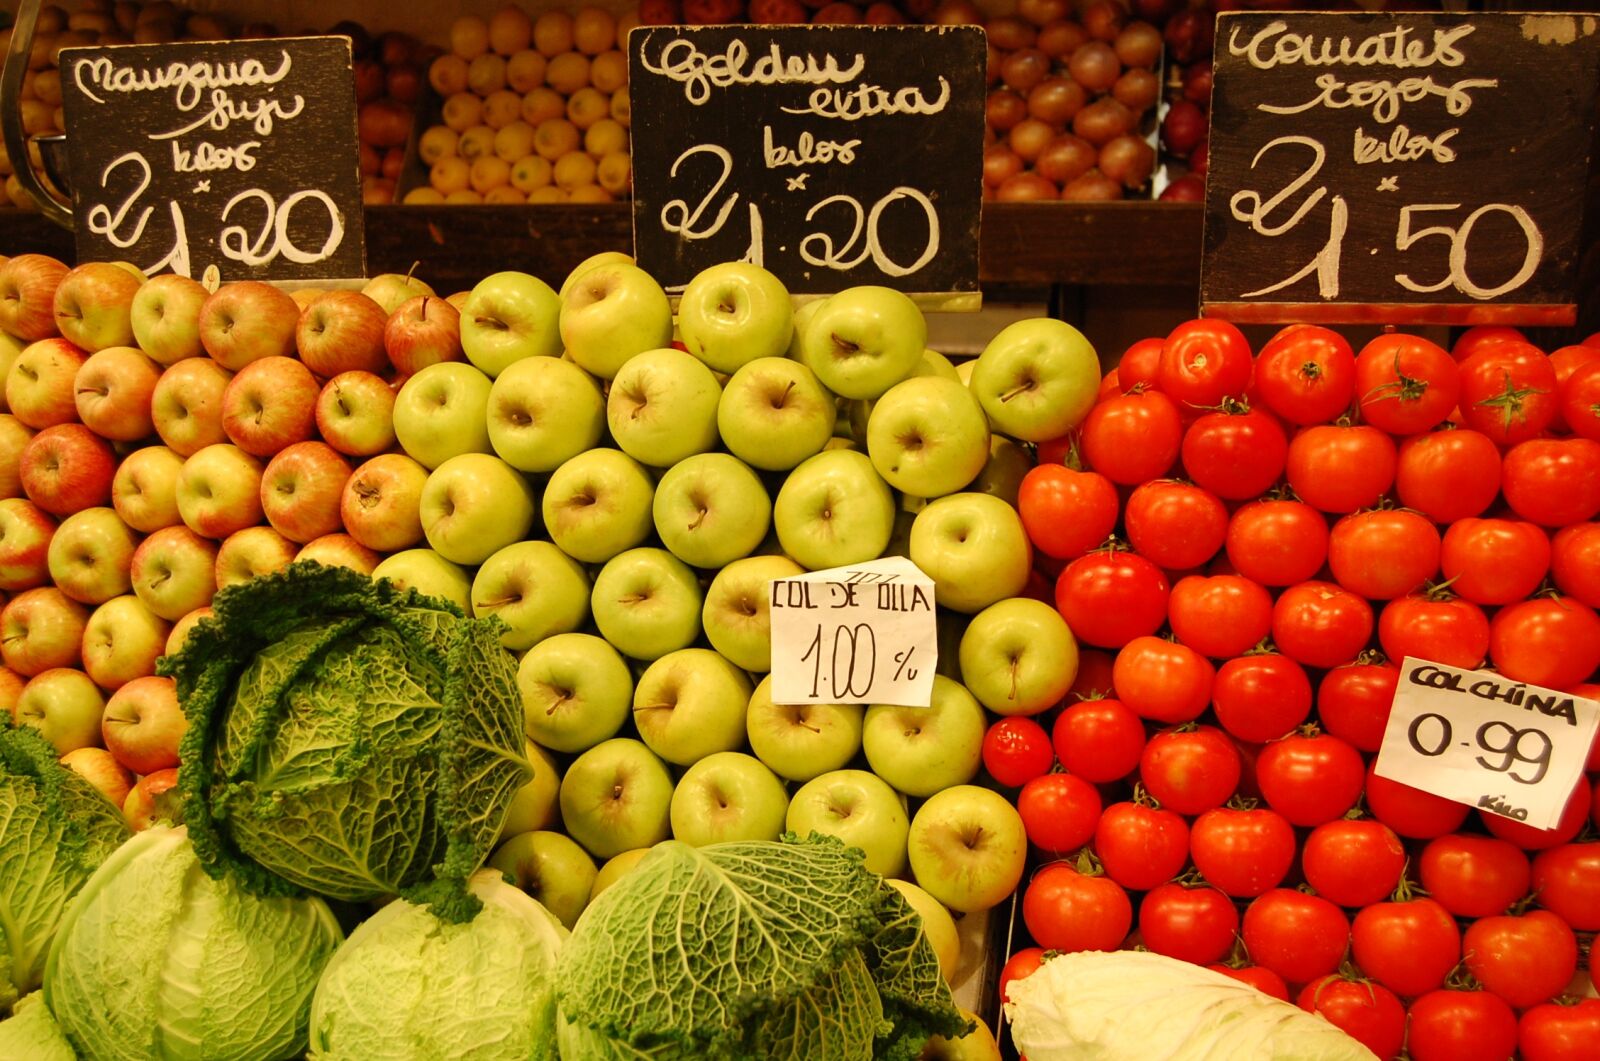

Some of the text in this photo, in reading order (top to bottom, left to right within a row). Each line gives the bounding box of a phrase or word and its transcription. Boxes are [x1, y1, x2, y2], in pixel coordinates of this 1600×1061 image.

[641, 33, 864, 105] Golden
[781, 76, 950, 120] extra
[172, 140, 261, 172] kilos
[764, 126, 861, 168] kilos
[1354, 125, 1459, 164] kilos
[88, 151, 154, 247] 2
[661, 144, 739, 239] 2
[1230, 135, 1327, 237] 2
[1241, 194, 1544, 300] 1.50
[772, 580, 931, 612] COL DE OLLA
[801, 623, 876, 699] 1.00
